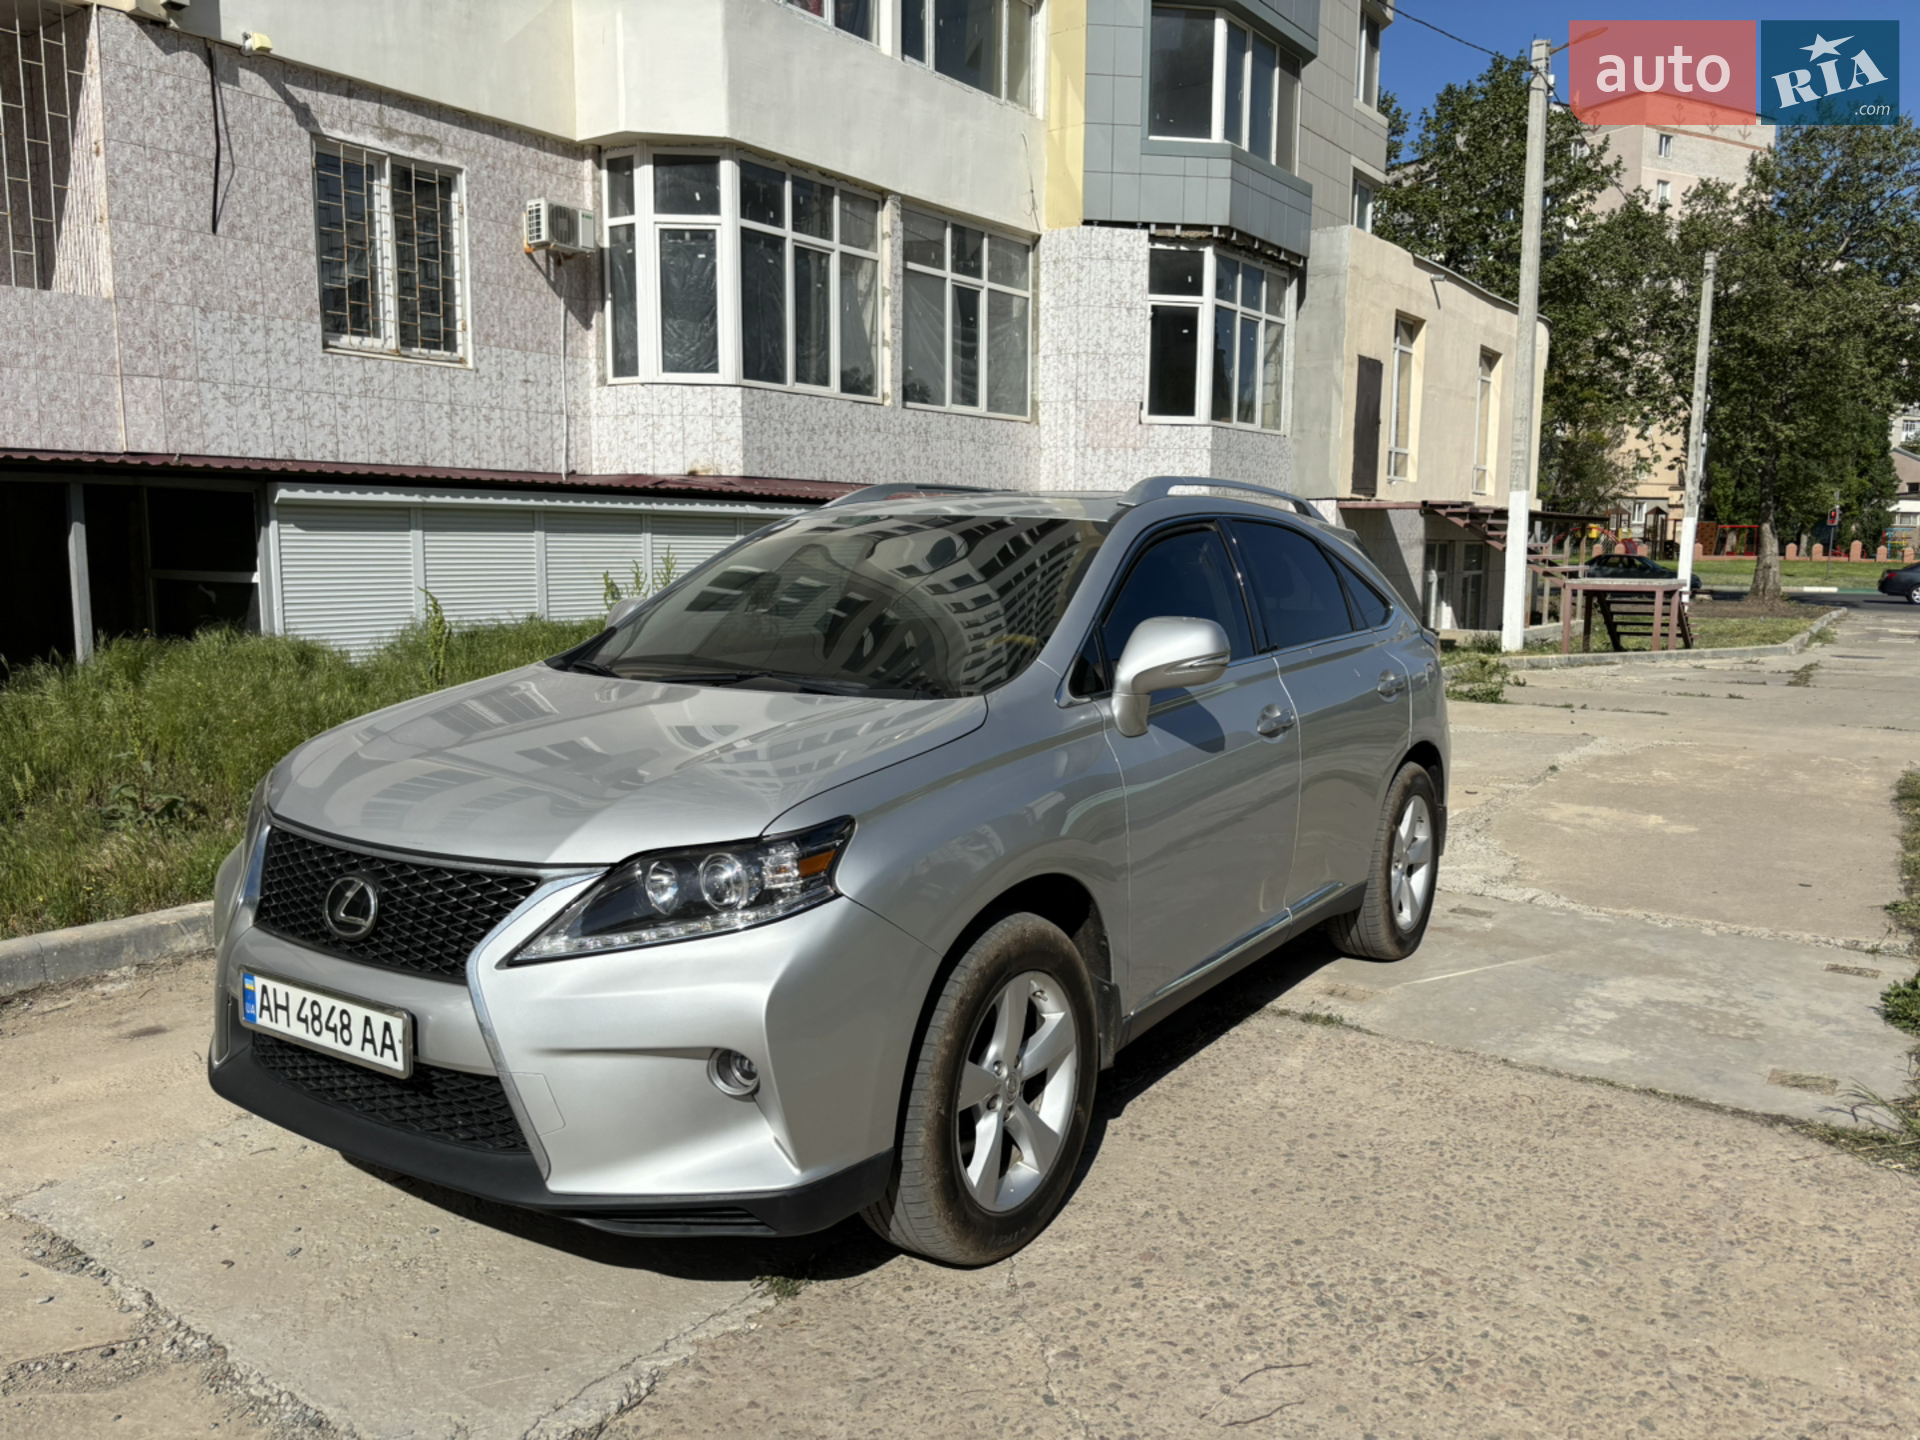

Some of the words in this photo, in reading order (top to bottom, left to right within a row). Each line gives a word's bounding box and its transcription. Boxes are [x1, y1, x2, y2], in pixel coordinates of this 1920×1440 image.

[259, 984, 290, 1028] AH
[296, 996, 353, 1047] 4848
[360, 1015, 398, 1063] AA
